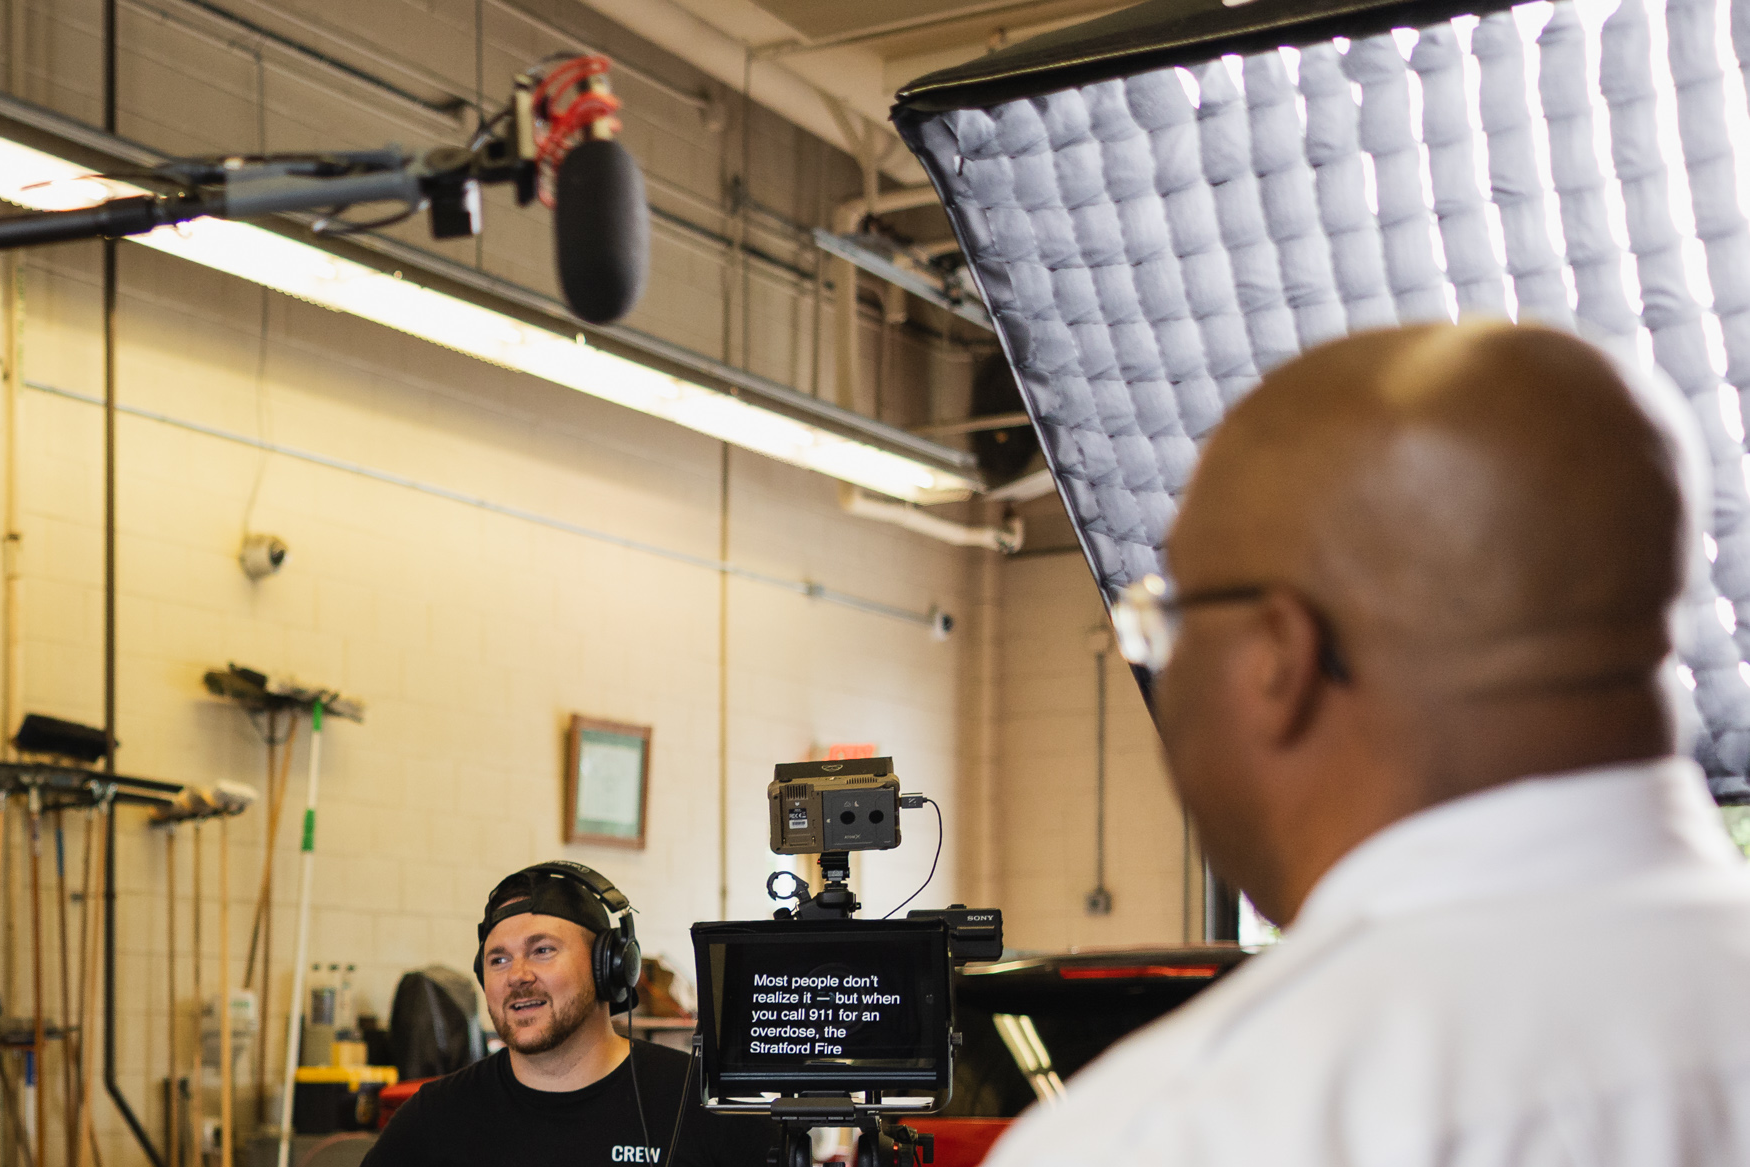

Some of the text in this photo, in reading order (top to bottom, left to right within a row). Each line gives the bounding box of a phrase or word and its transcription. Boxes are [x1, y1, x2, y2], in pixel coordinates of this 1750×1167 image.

[754, 974, 878, 989] Most people don't
[753, 991, 799, 1003] realize
[803, 992, 811, 1003] it
[836, 992, 858, 1004] but
[862, 992, 900, 1004] when
[751, 1008, 879, 1022] you call 911 for an
[750, 1025, 847, 1039] overdose, the
[750, 1041, 842, 1054] Stratford Fire
[611, 1145, 661, 1163] CREW
